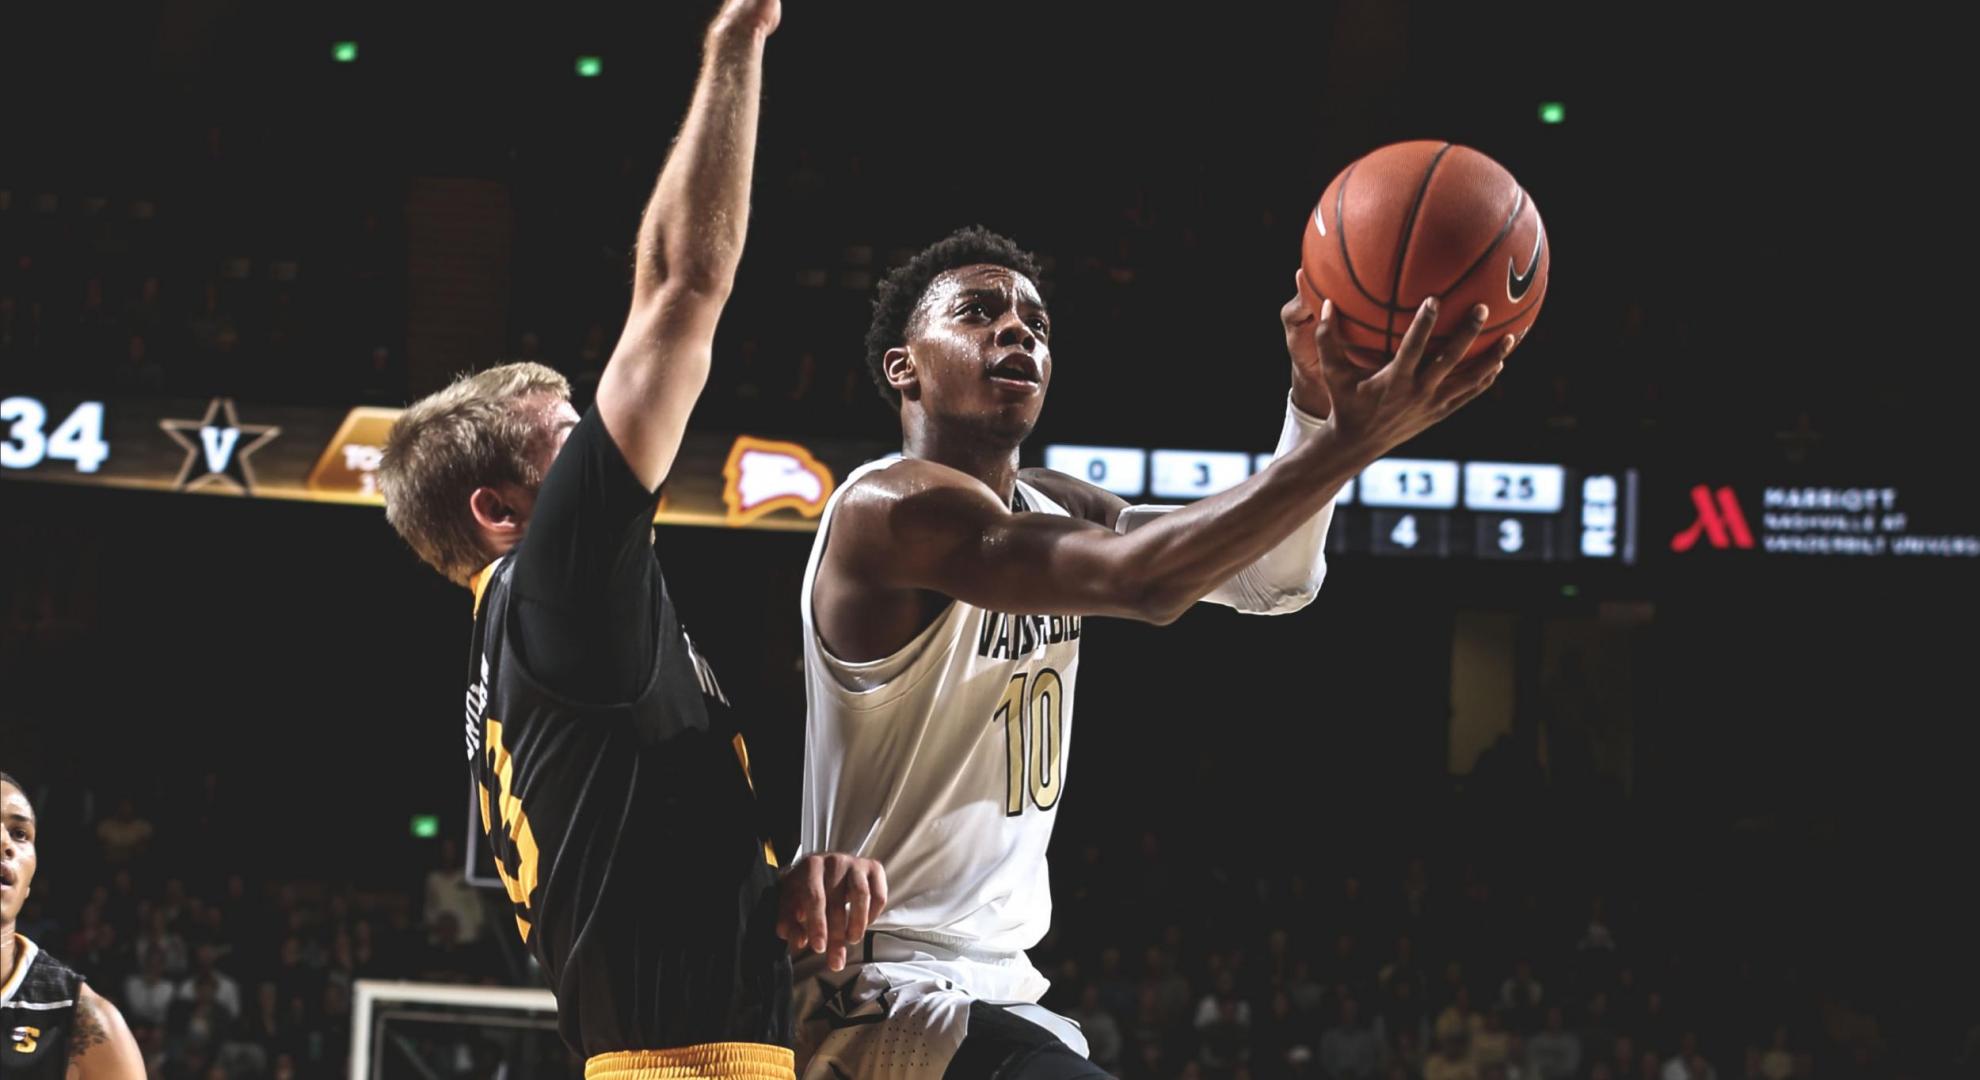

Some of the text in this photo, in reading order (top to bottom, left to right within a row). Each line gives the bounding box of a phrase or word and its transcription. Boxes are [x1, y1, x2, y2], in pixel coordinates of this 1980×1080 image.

[0, 395, 110, 473] 34
[200, 426, 240, 473] V
[1087, 459, 1107, 482] 0
[1194, 462, 1210, 486] 3
[1396, 472, 1434, 495] 13
[1494, 476, 1534, 499] 25
[1764, 487, 1895, 512] MARRIOTT
[1391, 514, 1418, 548] 4
[1764, 513, 1907, 531] NASHVILLE AT
[1498, 518, 1523, 552] 3
[1764, 534, 1886, 554] VANDERBILT
[993, 668, 1063, 817] 10
